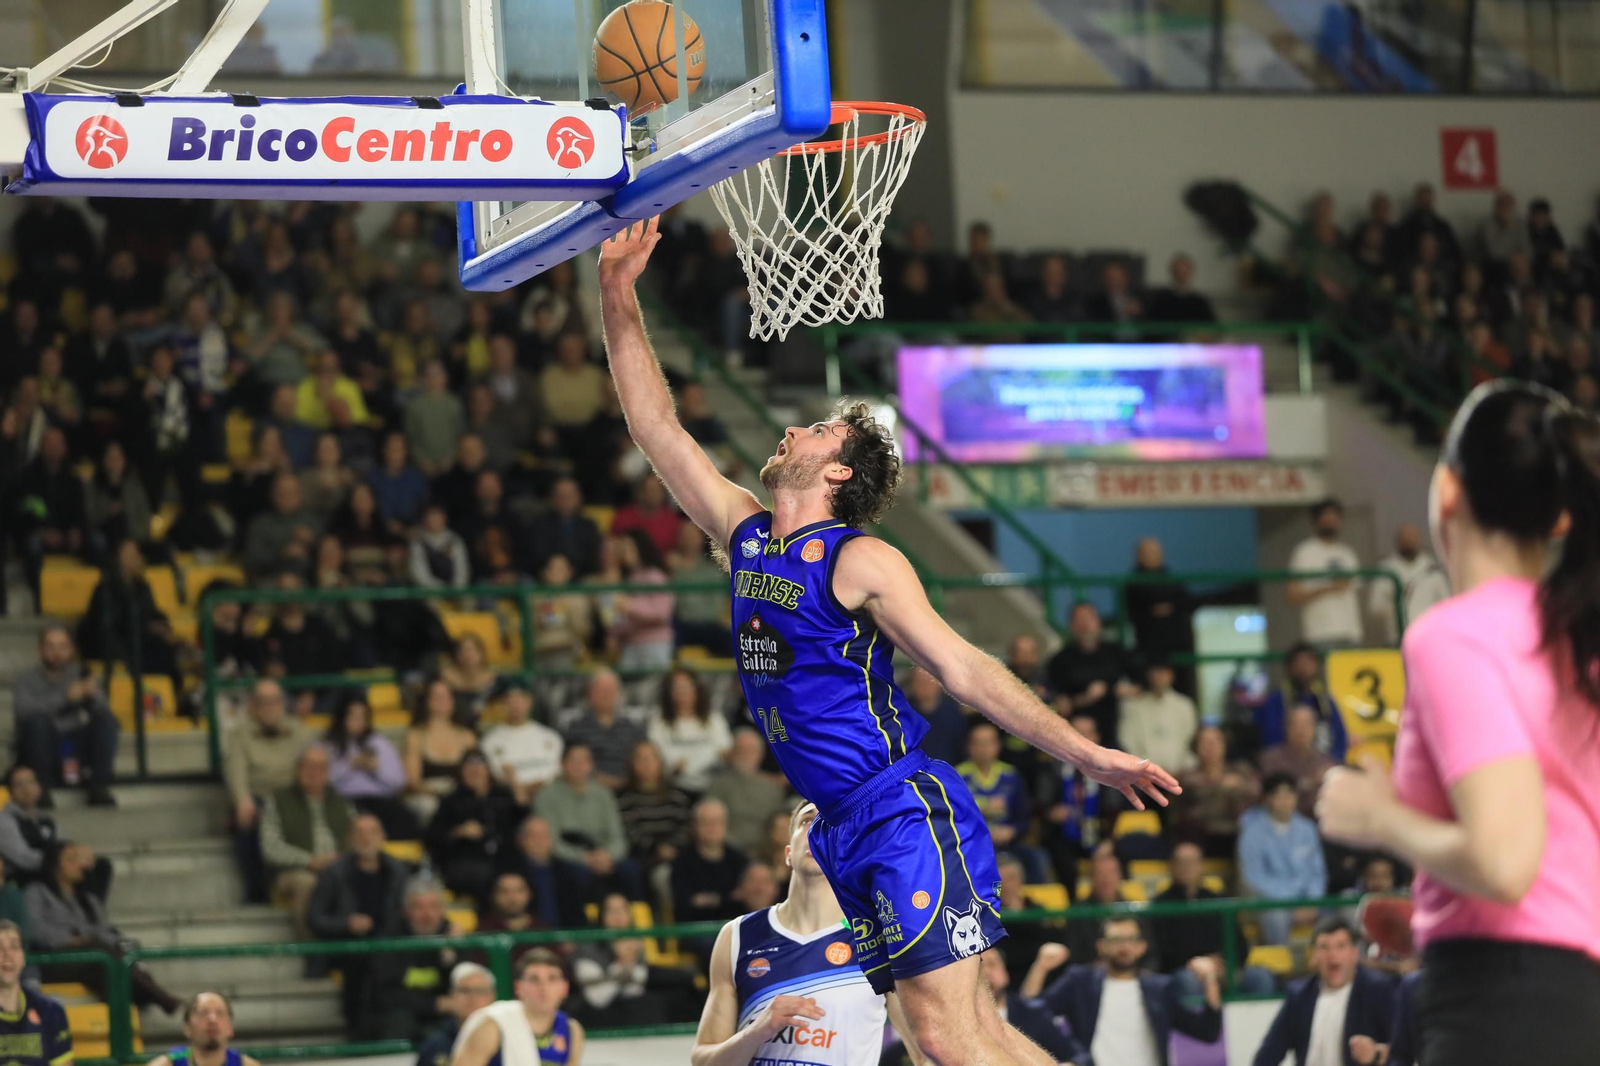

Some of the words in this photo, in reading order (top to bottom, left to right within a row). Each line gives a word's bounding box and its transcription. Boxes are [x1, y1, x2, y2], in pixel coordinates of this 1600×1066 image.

[167, 113, 513, 162] BricoCentro
[1454, 135, 1485, 179] 4
[740, 633, 778, 653] Estrella
[1354, 667, 1386, 723] 3
[757, 706, 790, 743] 24
